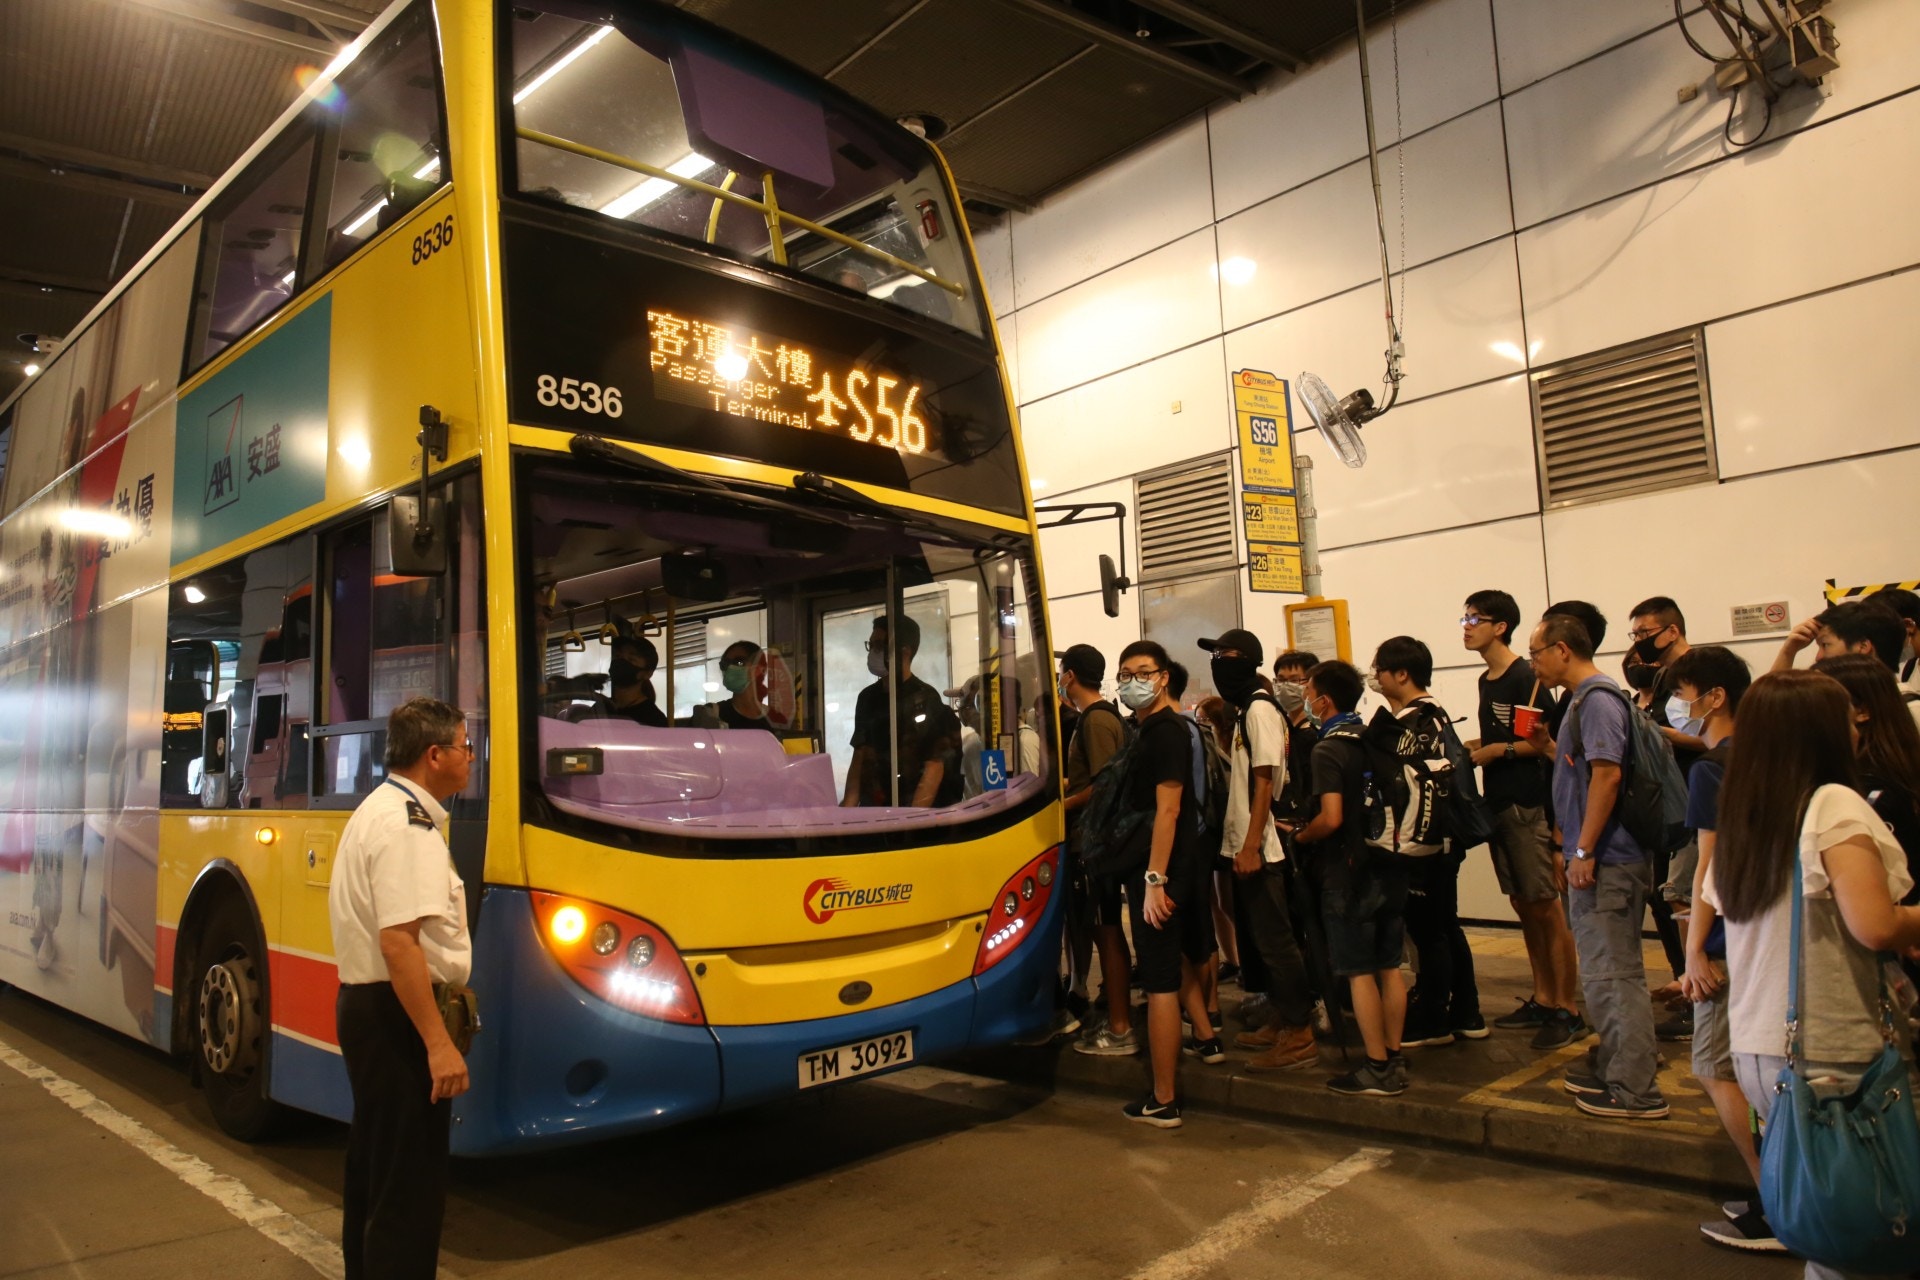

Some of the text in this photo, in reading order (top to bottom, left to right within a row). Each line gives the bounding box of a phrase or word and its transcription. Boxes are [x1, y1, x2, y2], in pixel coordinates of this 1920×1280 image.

[411, 214, 454, 266] 8536
[647, 310, 812, 388] 客運大樓
[537, 374, 623, 418] 8536
[650, 351, 780, 400] Passenger
[708, 389, 812, 430] Terminal
[847, 370, 926, 454] S56
[1252, 419, 1276, 444] S56
[248, 423, 281, 482] 安盛
[205, 455, 233, 504] AXA
[821, 884, 913, 909] CITYBUS 城巴
[806, 1034, 907, 1082] TM 3092
